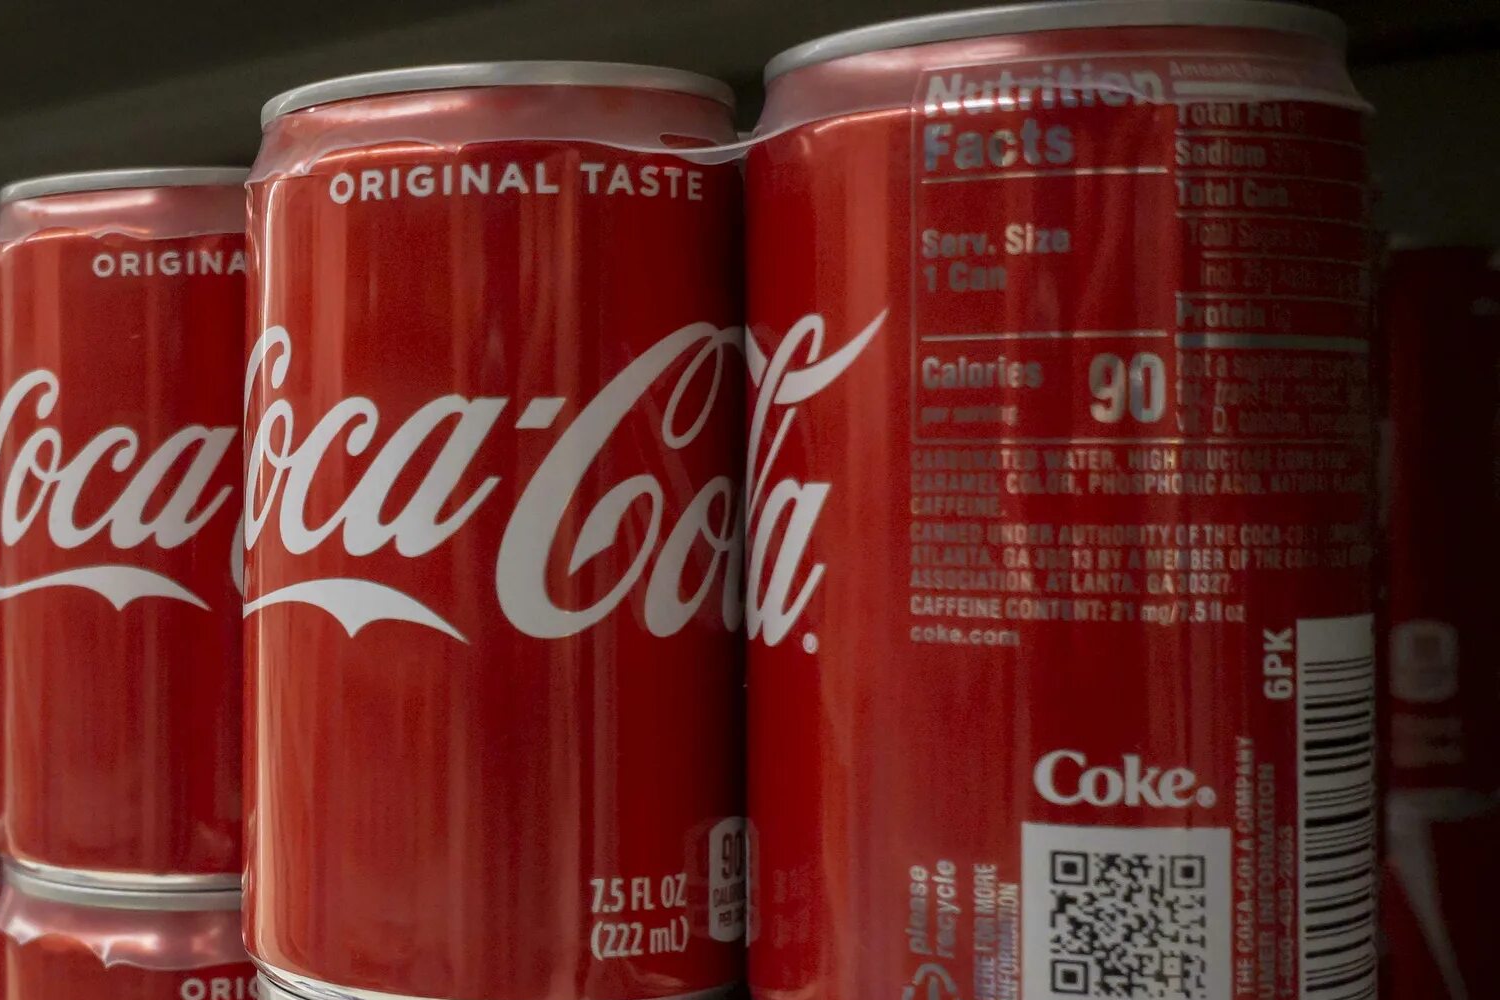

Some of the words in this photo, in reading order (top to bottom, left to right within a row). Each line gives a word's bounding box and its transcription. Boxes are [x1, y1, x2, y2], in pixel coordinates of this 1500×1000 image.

[924, 62, 1164, 115] Nutrition
[923, 118, 1075, 171] Facts
[1174, 138, 1267, 167] Sodium
[329, 161, 560, 204] ORIGINAL
[580, 162, 704, 202] TASTE
[922, 228, 997, 259] Serv.
[1005, 222, 1071, 255] Size
[948, 261, 1008, 293] Can
[922, 355, 1044, 389] Calories
[1089, 352, 1167, 423] 90
[910, 595, 1002, 618] CAFFEINE
[910, 623, 1020, 646] coke.com
[1263, 627, 1293, 700] 6PK
[1033, 749, 1199, 809] Coke
[1235, 735, 1255, 833] COMPANY
[1257, 763, 1275, 925] INFORMATION
[590, 877, 625, 913] 7.5
[631, 876, 656, 911] FL
[660, 872, 687, 909] OZ
[905, 864, 932, 955] please
[932, 859, 962, 959] recycle
[973, 863, 997, 914] MORE
[1235, 837, 1254, 954] COCA-COLA
[591, 921, 644, 961] (222
[649, 915, 690, 955] mL)
